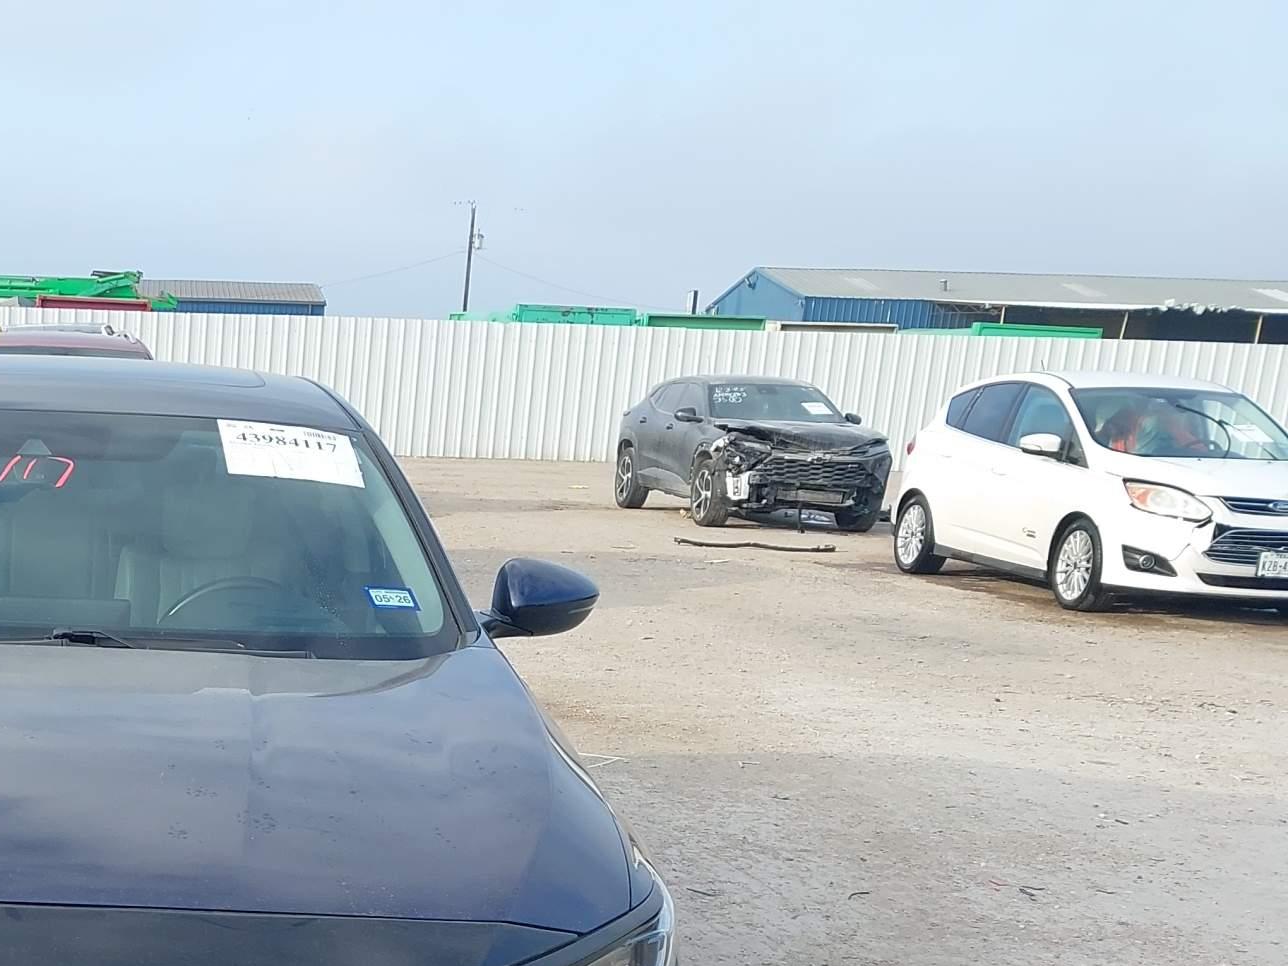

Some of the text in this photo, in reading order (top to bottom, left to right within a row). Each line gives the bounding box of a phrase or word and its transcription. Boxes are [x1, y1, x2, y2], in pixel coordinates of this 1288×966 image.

[236, 432, 337, 453] 43984117
[374, 594, 411, 604] 05 26
